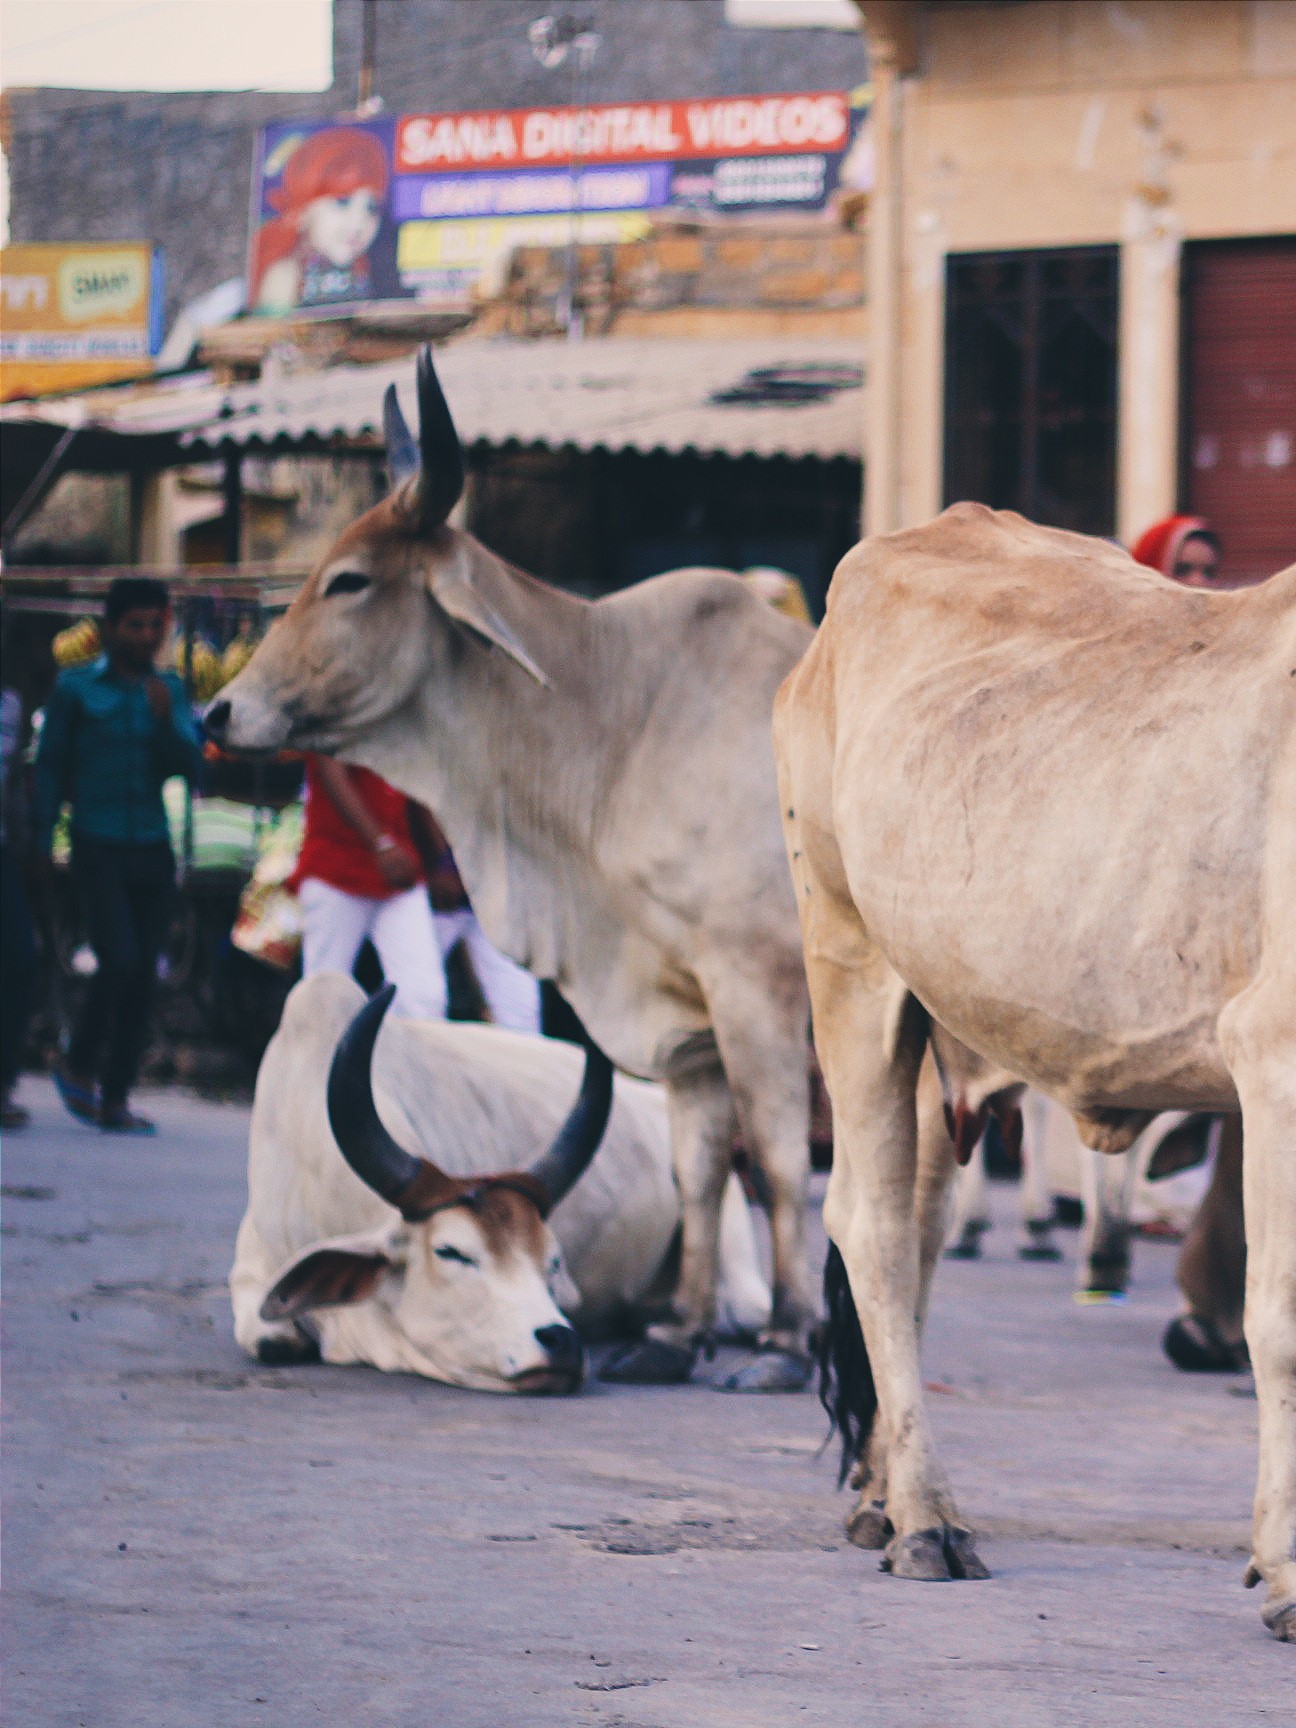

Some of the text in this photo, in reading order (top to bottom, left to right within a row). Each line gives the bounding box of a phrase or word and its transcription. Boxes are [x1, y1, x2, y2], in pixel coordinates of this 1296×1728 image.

[402, 95, 847, 166] SANA DIGITAL VIDEOS
